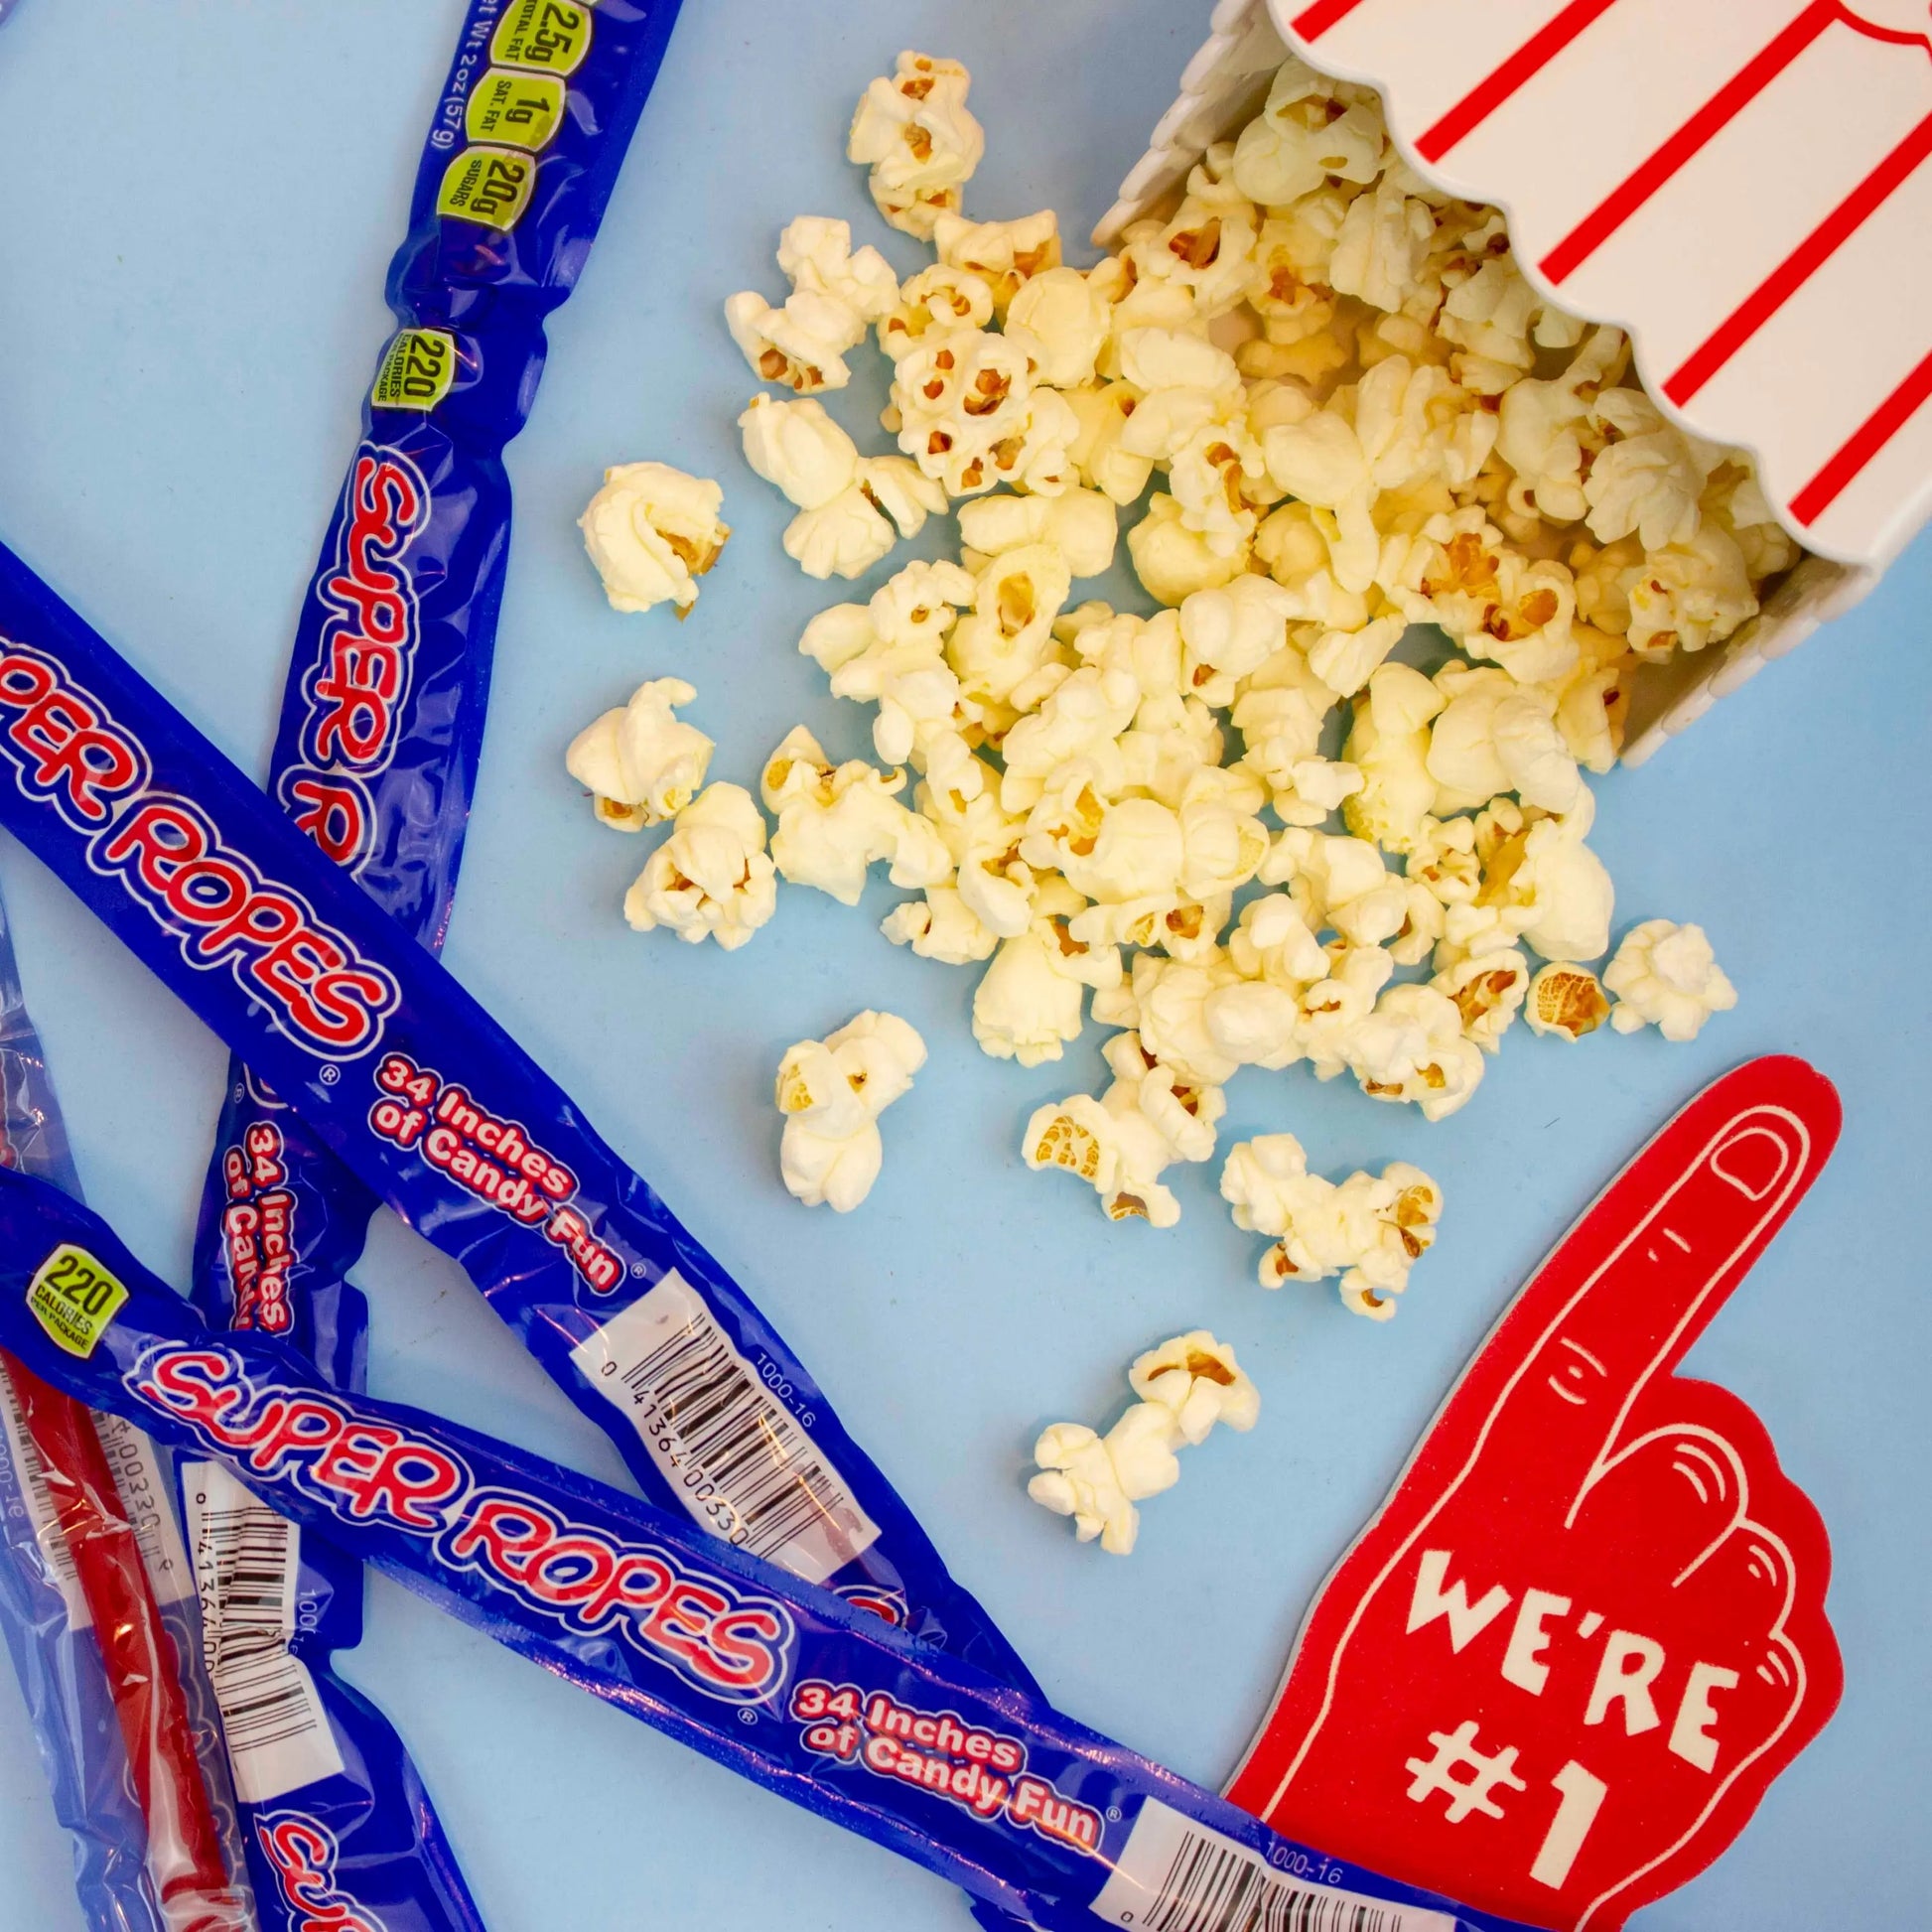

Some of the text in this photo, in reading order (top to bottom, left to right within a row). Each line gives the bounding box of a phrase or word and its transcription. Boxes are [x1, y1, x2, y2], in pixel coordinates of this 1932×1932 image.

[466, 20, 492, 49] Wt
[504, 38, 523, 63] FAT
[524, 2, 580, 63] 2.5g
[481, 109, 500, 132] FAT
[504, 96, 550, 124] 1g
[449, 159, 483, 207] SUGARS
[470, 159, 525, 215] 20g
[403, 335, 446, 397] 220
[315, 455, 420, 765] SUPER
[0, 655, 390, 1047] PER ROPES
[249, 1128, 279, 1182] 34
[381, 1059, 570, 1194] 34 Inches
[226, 1152, 249, 1194] of
[375, 1104, 616, 1286] of Candy Fun
[45, 1255, 113, 1315] 220
[260, 1193, 292, 1326] Inches
[35, 1284, 93, 1335] CALORIES
[49, 1311, 89, 1350] PACKAGE
[757, 1352, 817, 1429] 1000-16
[136, 1351, 782, 1688] SUPER ROPES
[1405, 1549, 1739, 1774] WE'RE
[797, 1687, 1017, 1768] 34 Inches
[808, 1724, 1095, 1843] of Candy Fun
[1404, 1721, 1608, 1890] #1
[1264, 1842, 1343, 1884] 1000-16
